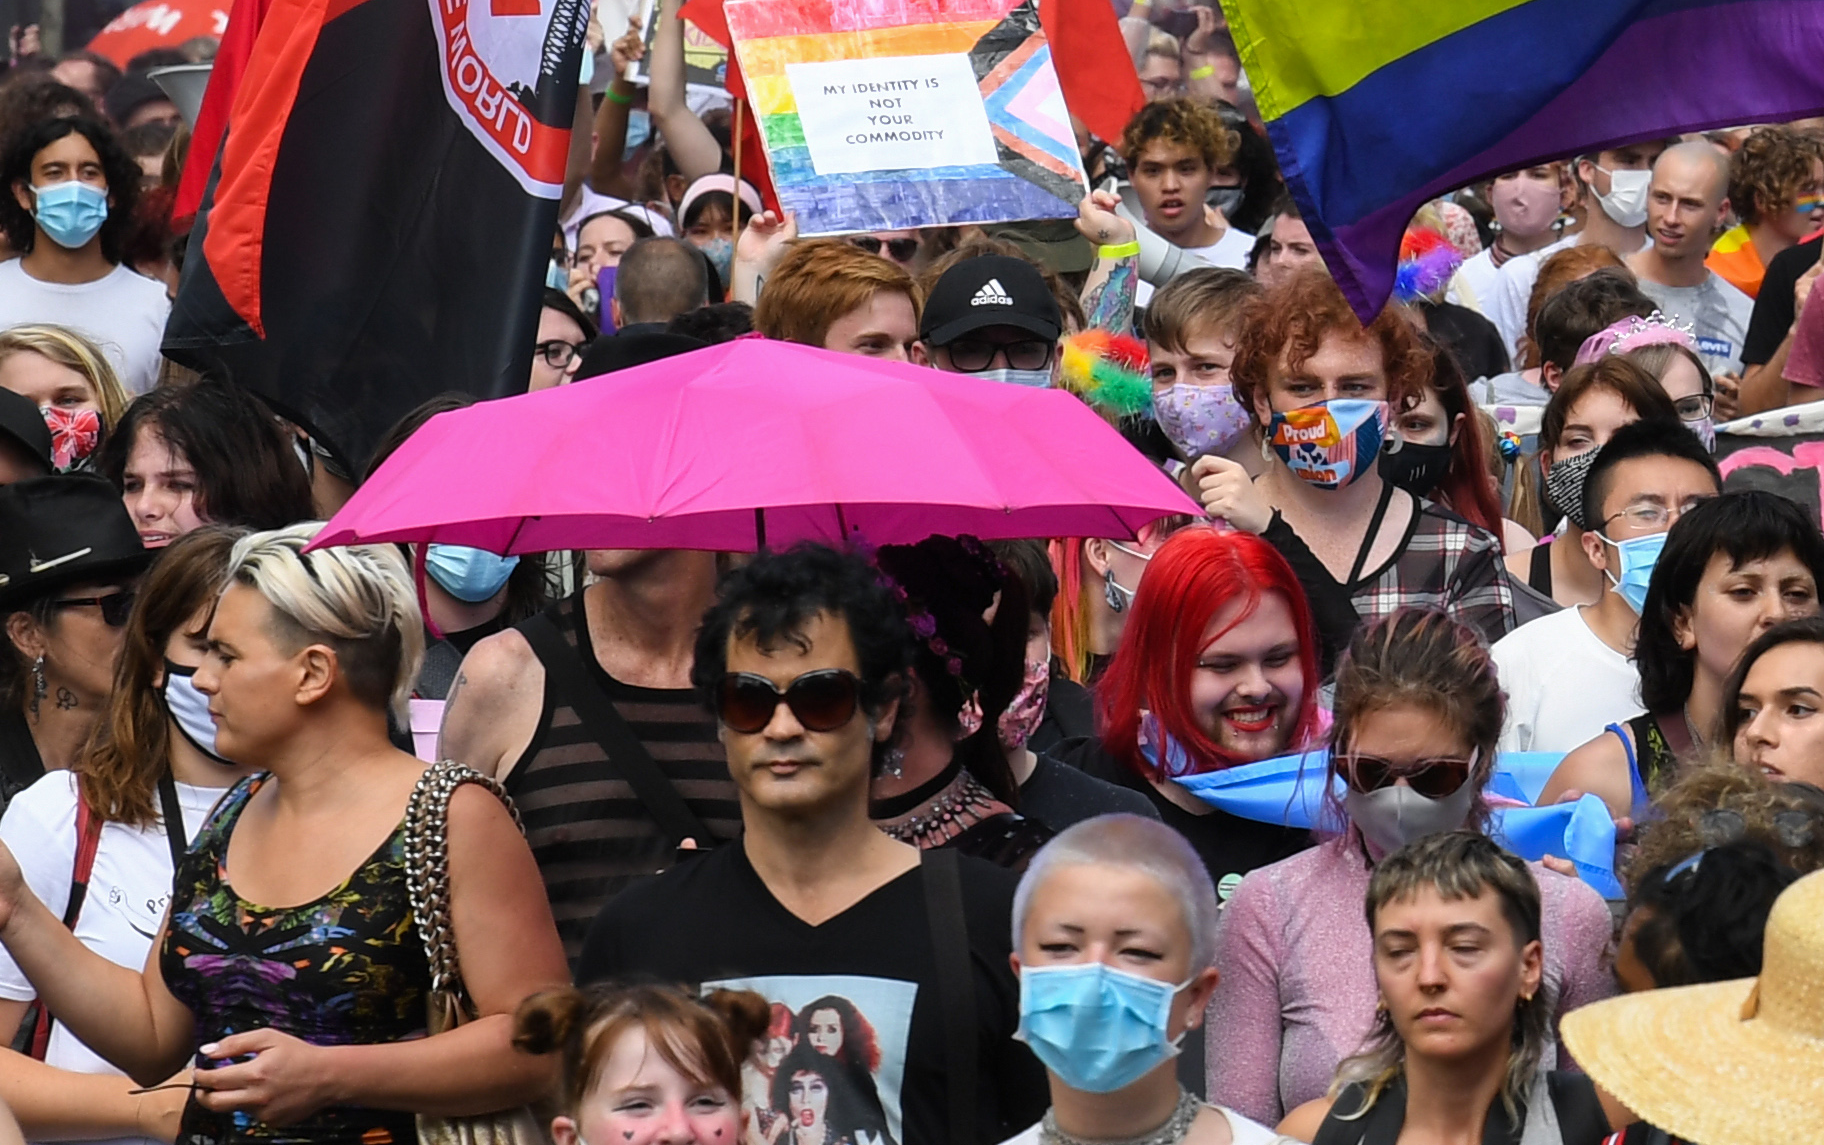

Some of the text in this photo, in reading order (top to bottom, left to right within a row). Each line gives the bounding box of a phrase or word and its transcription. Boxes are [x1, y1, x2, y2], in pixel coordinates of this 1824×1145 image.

[823, 77, 940, 96] MY IDENTITY IS
[869, 97, 902, 109] NOT
[867, 114, 914, 126] YOUR
[845, 129, 944, 145] COMMODITY
[970, 294, 1013, 307] adidas
[1282, 418, 1326, 442] Proud
